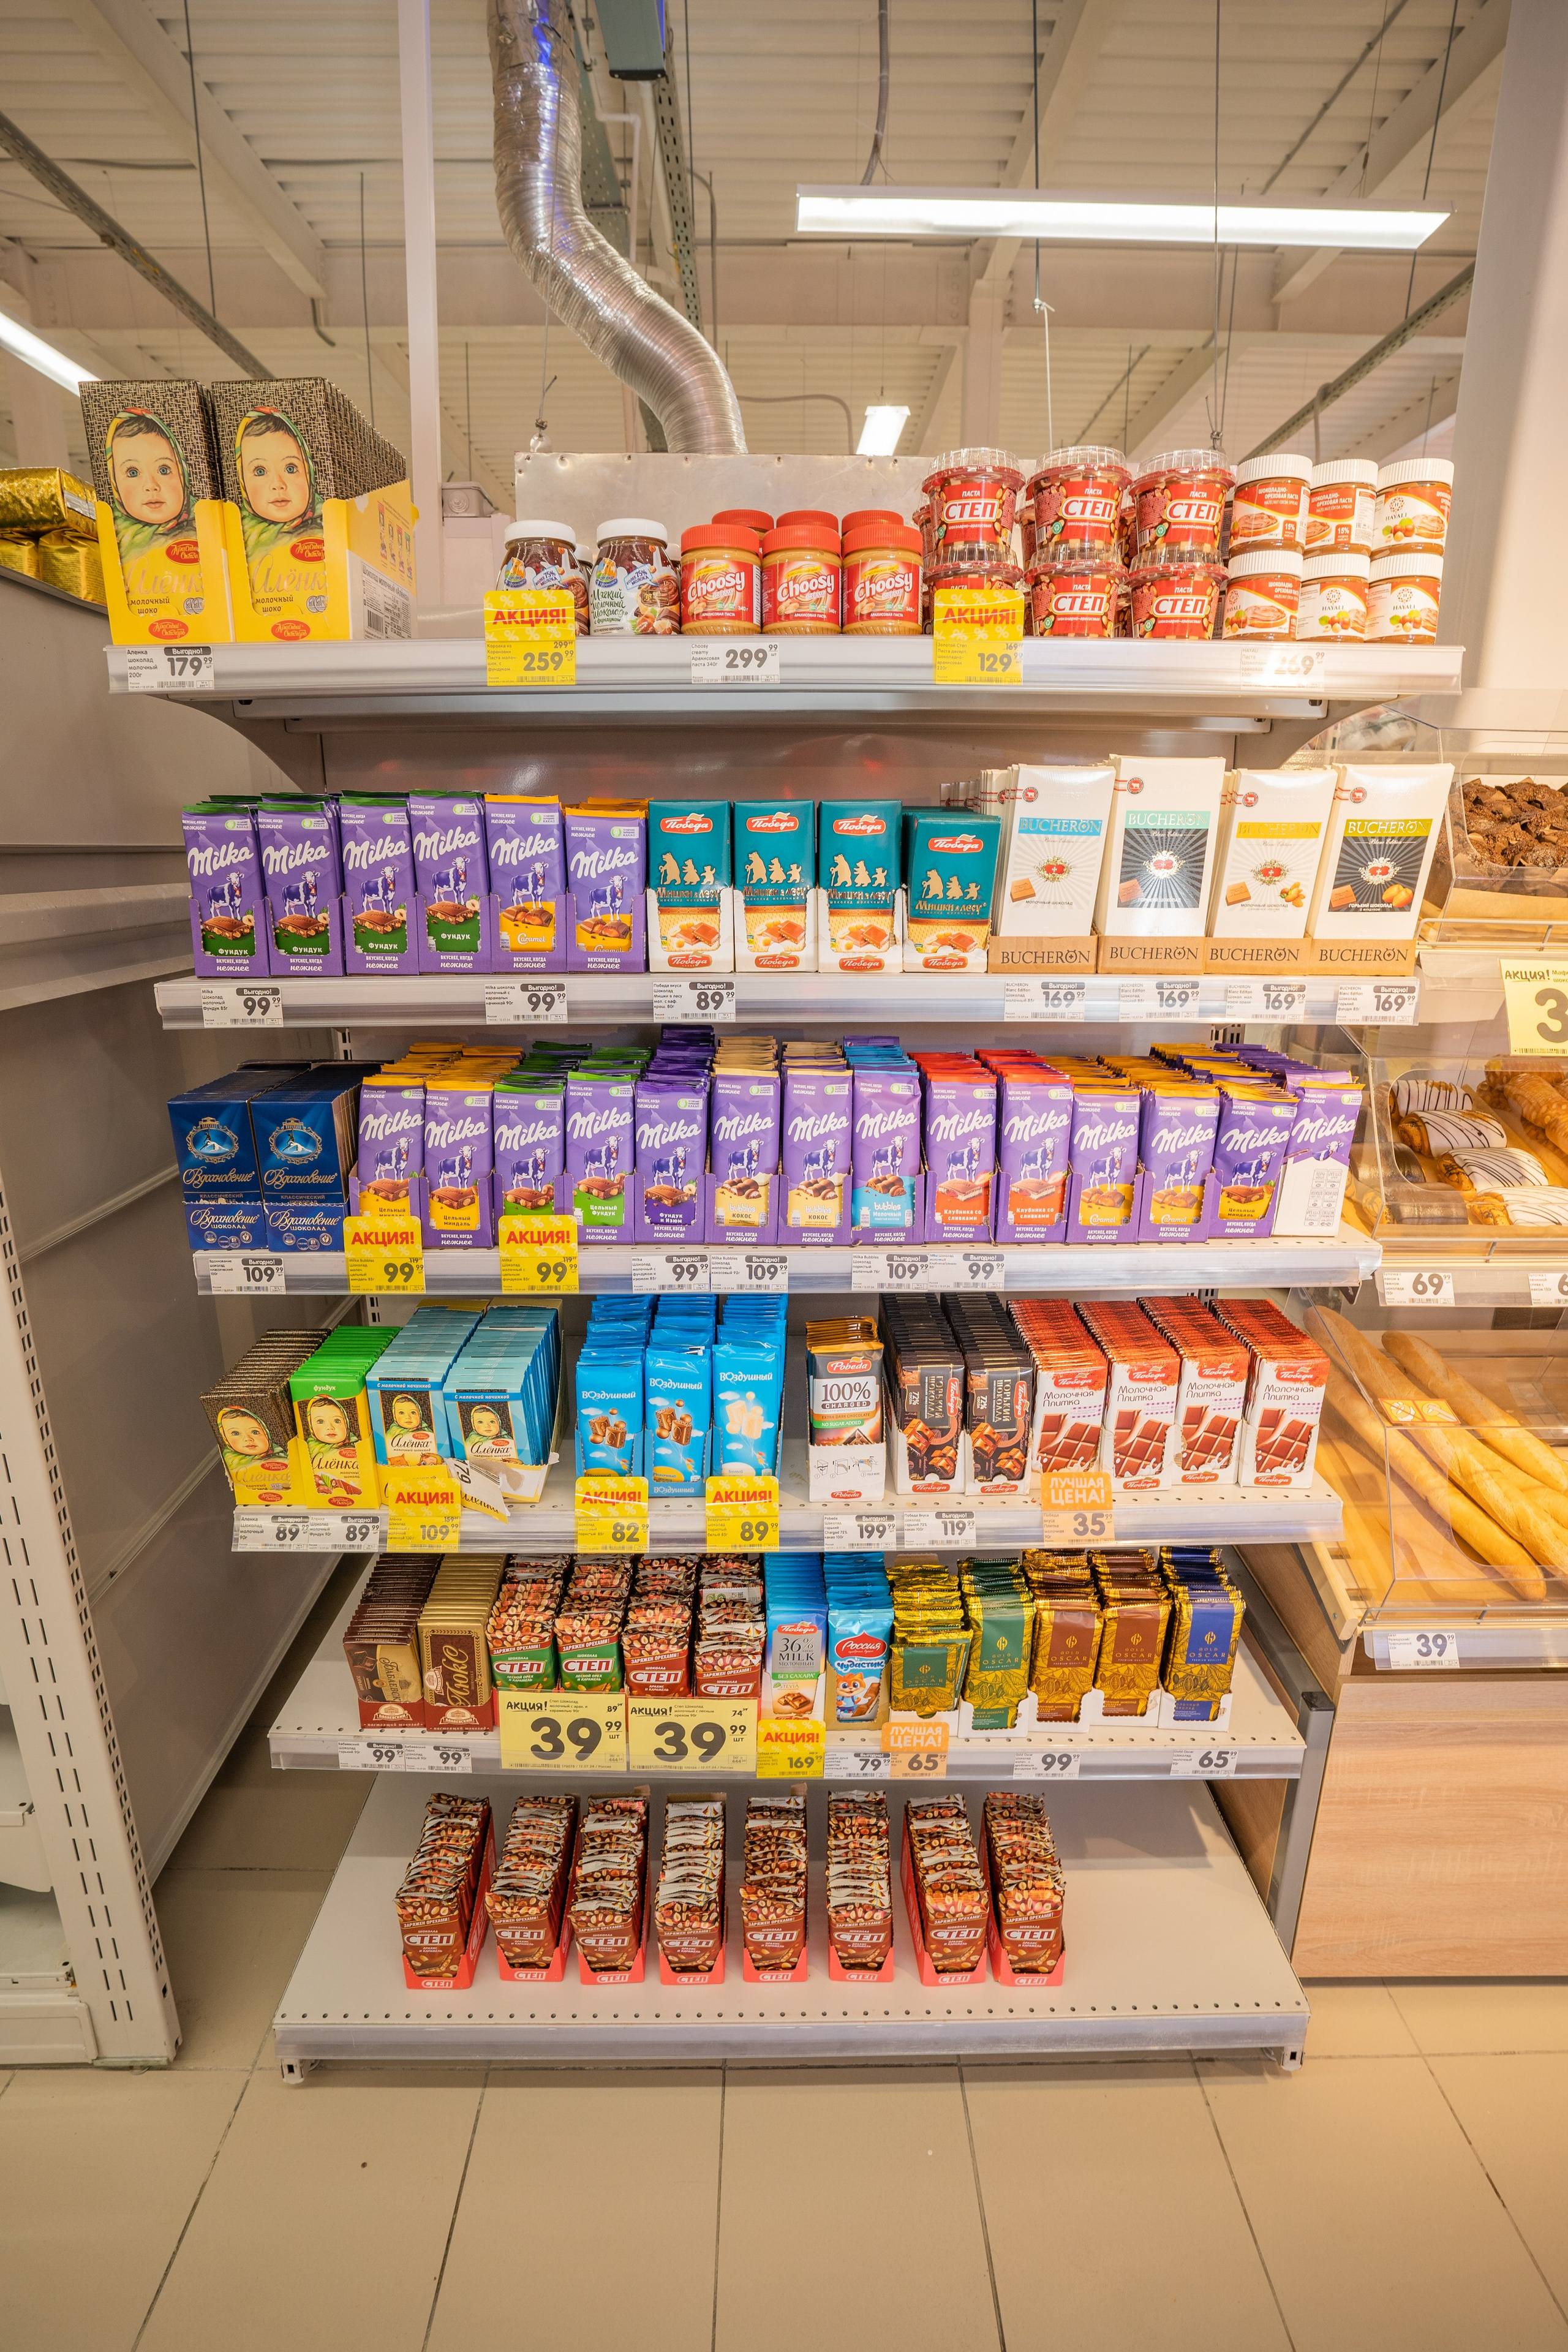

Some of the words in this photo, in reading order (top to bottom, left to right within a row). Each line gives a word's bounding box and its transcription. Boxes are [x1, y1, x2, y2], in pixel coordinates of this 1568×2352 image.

[944, 501, 997, 521] СТЕП
[687, 571, 745, 602] Choosy
[255, 595, 293, 604] молочный
[1052, 594, 1107, 613] СТЕП
[492, 608, 567, 627] АКЦИЯ!
[942, 608, 1016, 627] АКЦИЯ!
[167, 657, 202, 676] 179
[523, 652, 563, 671] 259
[725, 649, 767, 669] 299
[978, 653, 1012, 673] 129
[665, 817, 708, 830] Победа
[491, 834, 559, 866] Milka
[187, 842, 254, 876] Milka
[915, 900, 955, 913] Мишки
[517, 933, 546, 943] Caramel
[1001, 949, 1091, 966] BUCHERON
[1209, 947, 1300, 962] BUCHERON
[1505, 969, 1550, 981] АКЦИЯ!
[243, 997, 270, 1016] 99
[527, 993, 555, 1012] 99
[696, 991, 724, 1011] 89
[1043, 991, 1075, 1008] 169
[1157, 991, 1189, 1008] 169
[1264, 993, 1295, 1011] 169
[1374, 995, 1405, 1012] 169
[360, 1109, 424, 1142] Milka
[636, 1119, 701, 1150] Milka
[183, 1166, 255, 1189] Вдохновение
[873, 1202, 902, 1212] bubbles
[352, 1231, 414, 1247] АКЦИЯ!
[506, 1231, 570, 1246] АКЦИЯ!
[243, 1267, 274, 1283] 109
[383, 1263, 414, 1283] 99
[536, 1262, 567, 1283] 99
[672, 1264, 699, 1281] 99
[745, 1264, 778, 1281] 109
[887, 1263, 919, 1280] 109
[968, 1262, 995, 1280] 99
[1412, 1273, 1444, 1295] 69
[831, 1360, 869, 1371] Pobeda
[1058, 1376, 1092, 1386] Победа
[1187, 1382, 1235, 1391] Молочная
[822, 1382, 872, 1402] 100%
[1186, 1390, 1221, 1398] Плитка
[390, 1434, 429, 1449] Алёнка
[1049, 1477, 1104, 1489] ЛУЧШАЯ
[395, 1491, 454, 1506] АКЦИЯ!
[712, 1491, 772, 1506] АКЦИЯ!
[1050, 1488, 1105, 1506] ЦЕНА!
[612, 1522, 639, 1542] 82
[740, 1521, 769, 1541] 89
[858, 1523, 887, 1539] 199
[941, 1520, 965, 1536] 119
[1073, 1512, 1105, 1536] 35
[275, 1525, 300, 1542] 89
[345, 1525, 370, 1542] 89
[420, 1525, 449, 1541] 109
[586, 1638, 610, 1648] ОРЕХАМИ!
[780, 1637, 813, 1652] 36%
[842, 1640, 881, 1652] Россия
[1416, 1634, 1447, 1657] 39
[563, 1659, 614, 1672] СТЕП
[778, 1653, 815, 1662] MILK
[507, 1702, 548, 1712] АКЦИЯ!
[631, 1706, 673, 1717] АКЦИЯ!
[530, 1717, 602, 1762] 39
[654, 1721, 726, 1763] 39
[788, 1757, 815, 1770] 169
[859, 1758, 881, 1771] 79
[908, 1754, 940, 1771] 65
[1041, 1753, 1072, 1771] 99
[1199, 1751, 1229, 1768] 65
[405, 1933, 454, 1946] СТЕП
[747, 1930, 798, 1942] СТЕП
[1015, 1977, 1048, 1986] СТЕП
